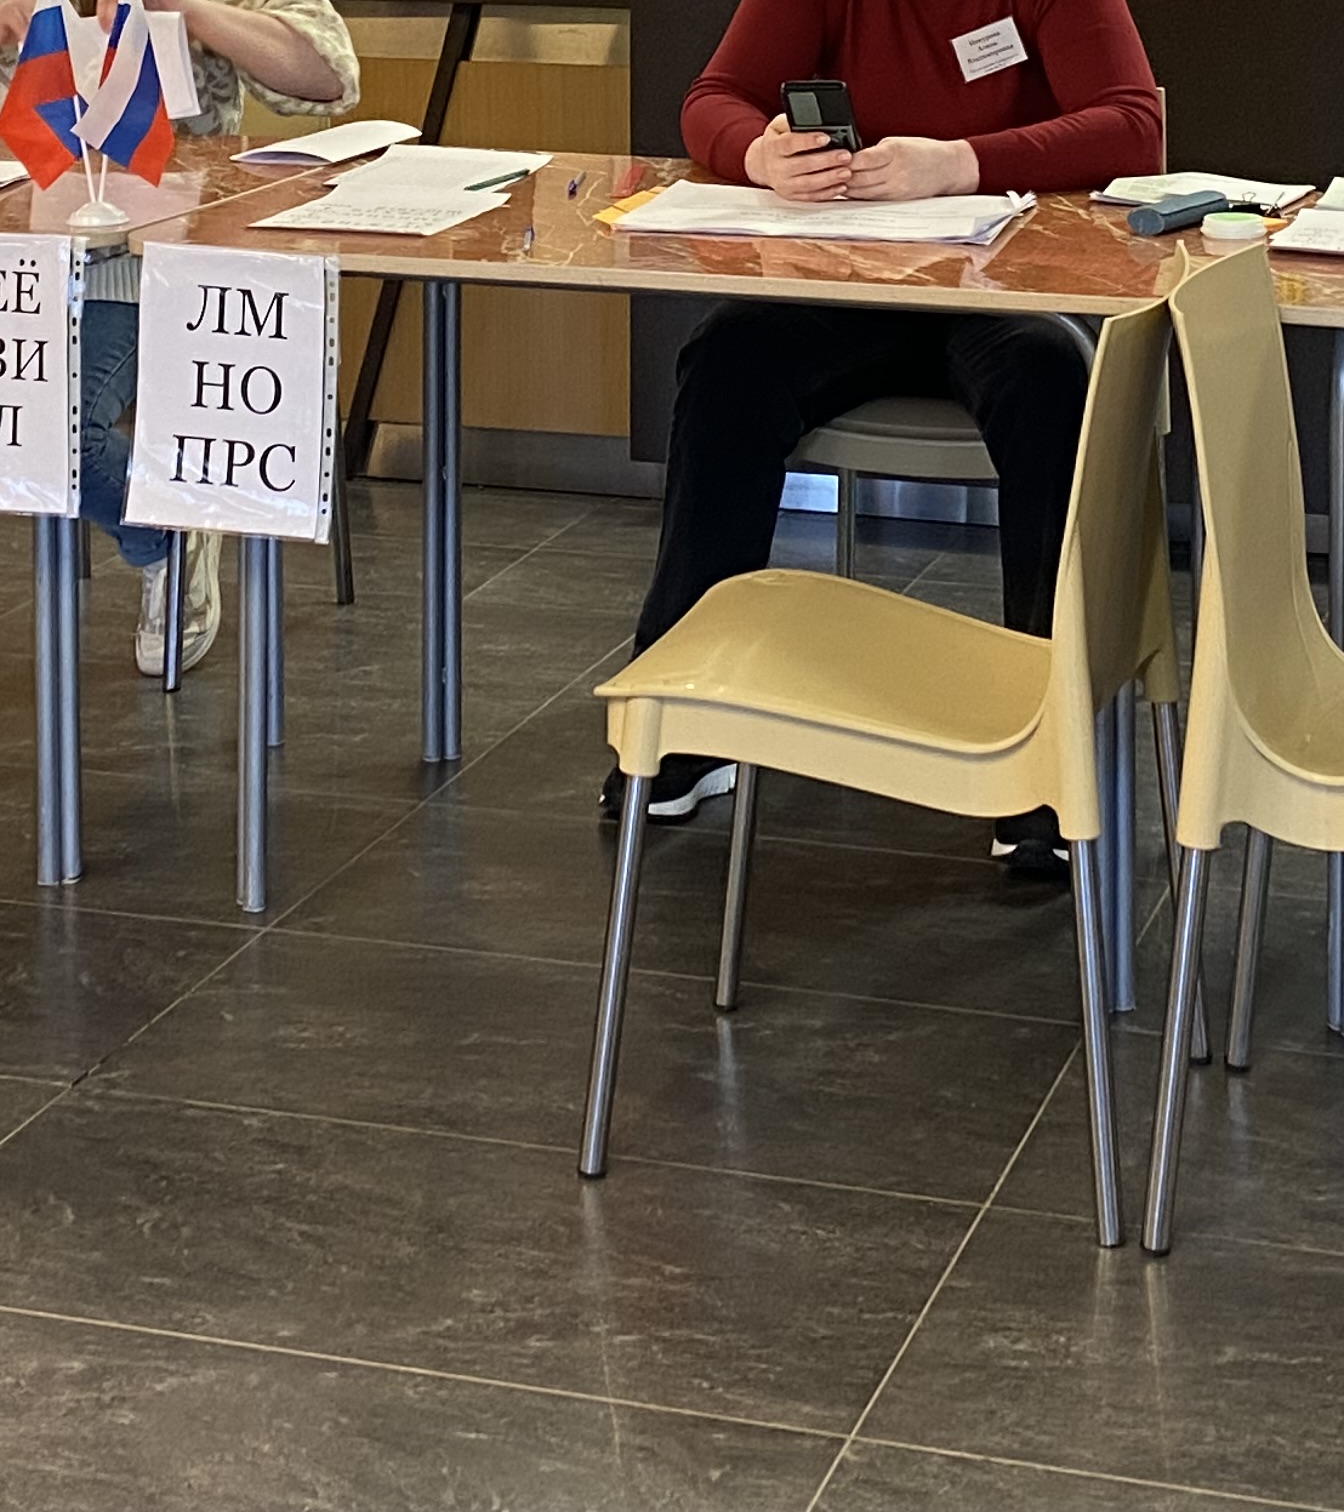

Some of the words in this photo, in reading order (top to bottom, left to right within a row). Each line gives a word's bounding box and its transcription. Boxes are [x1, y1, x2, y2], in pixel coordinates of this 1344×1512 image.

[186, 284, 290, 340] ЛМ
[190, 359, 282, 415] НО
[169, 434, 296, 492] ПРС
